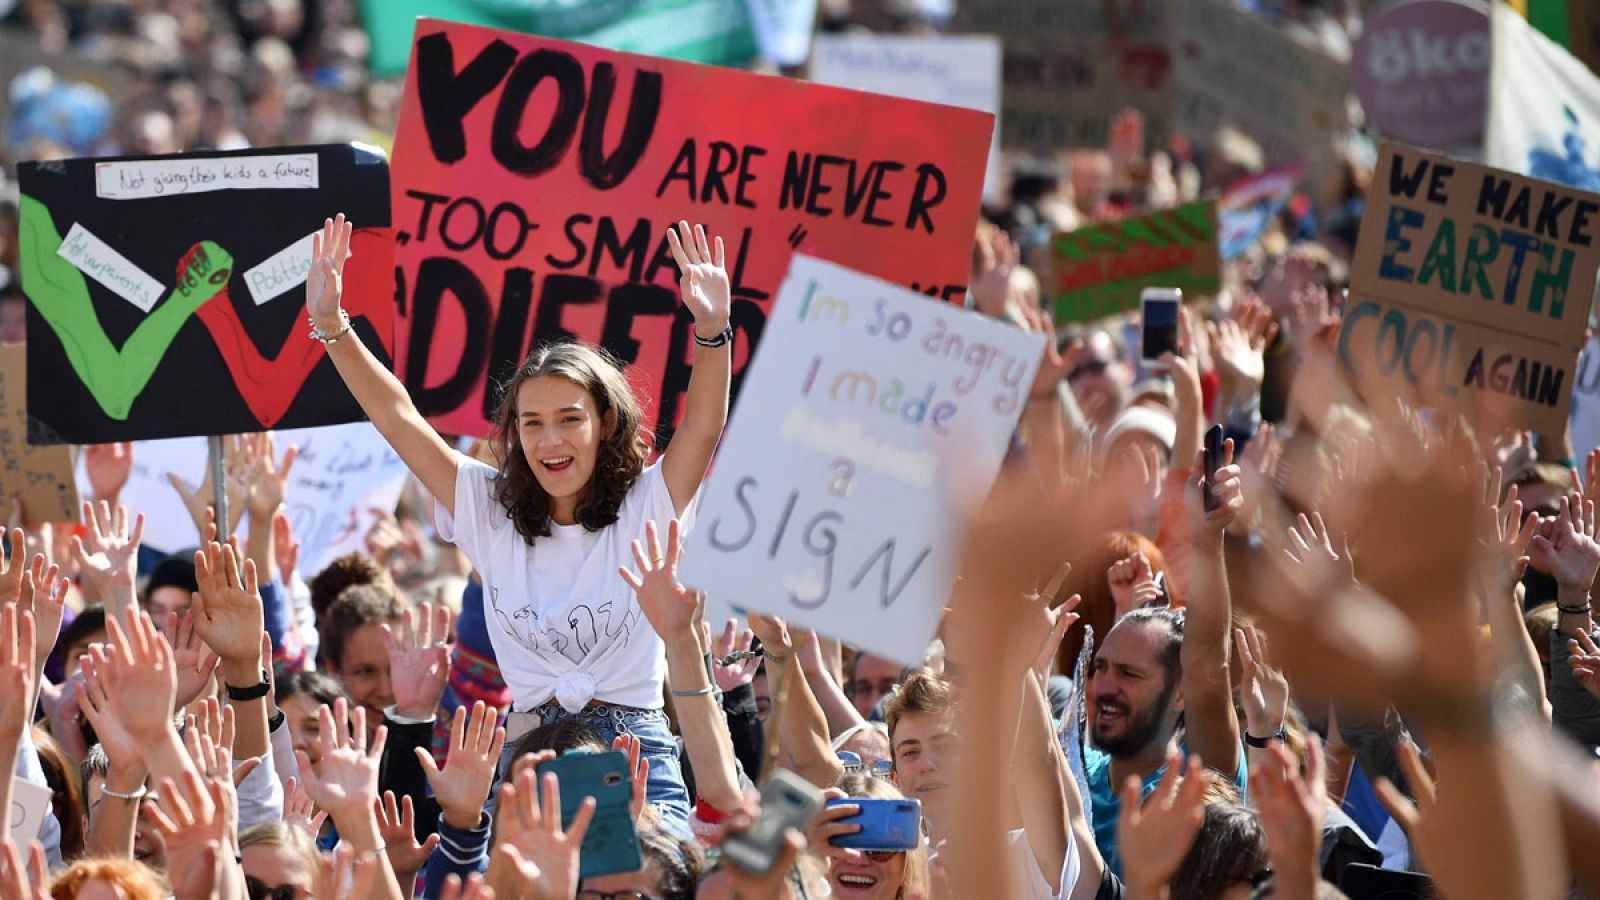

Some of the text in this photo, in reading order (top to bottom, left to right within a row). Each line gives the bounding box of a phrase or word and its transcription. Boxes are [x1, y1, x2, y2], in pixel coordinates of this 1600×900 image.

[119, 168, 145, 191] Not
[223, 164, 251, 180] kids
[258, 169, 268, 178] a
[273, 161, 311, 180] future
[417, 32, 947, 234] YOU ARE NEVER
[1388, 154, 1600, 248] WE MAKE
[1379, 204, 1576, 320] EARTH
[801, 355, 957, 436] I made
[864, 297, 913, 342] so
[922, 316, 1028, 417] angry
[1338, 301, 1459, 397] COOL
[1464, 346, 1565, 409] AGAIN
[826, 456, 856, 500] a
